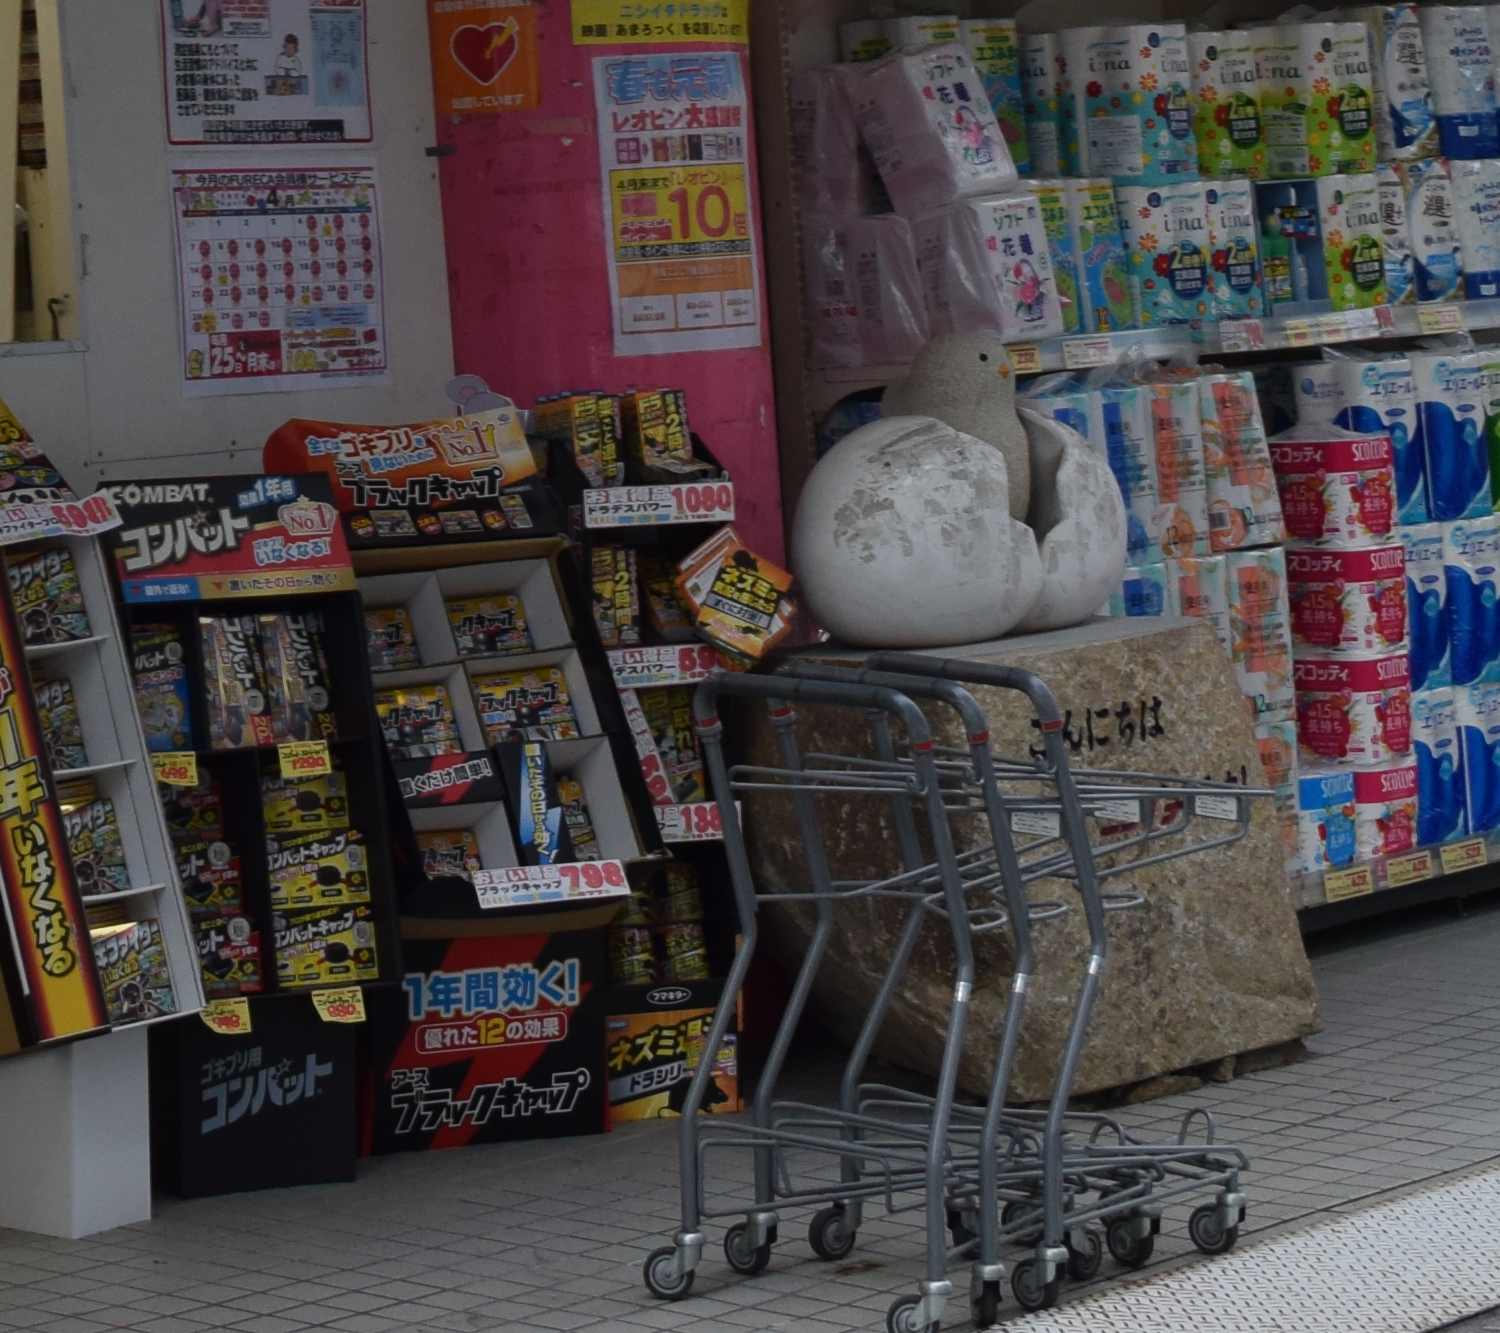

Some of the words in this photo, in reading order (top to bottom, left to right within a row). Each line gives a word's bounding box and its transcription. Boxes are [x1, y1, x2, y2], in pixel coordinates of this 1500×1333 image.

[1271, 447, 1324, 463] スコッティ
[111, 483, 211, 506] COMBAT
[340, 466, 505, 506] ブラックキャップ
[672, 484, 731, 512] 1080
[120, 507, 250, 572] コンバット
[1288, 554, 1344, 572] スコッティ
[560, 862, 624, 890] 798
[402, 958, 580, 1021] 1年間効く!
[424, 1016, 561, 1049] 優れた12の効果
[201, 1046, 263, 1084] ゴキブリ用
[391, 1067, 430, 1088] アース
[201, 1053, 334, 1134] コンバット
[391, 1067, 590, 1134] ブラックキャップ
